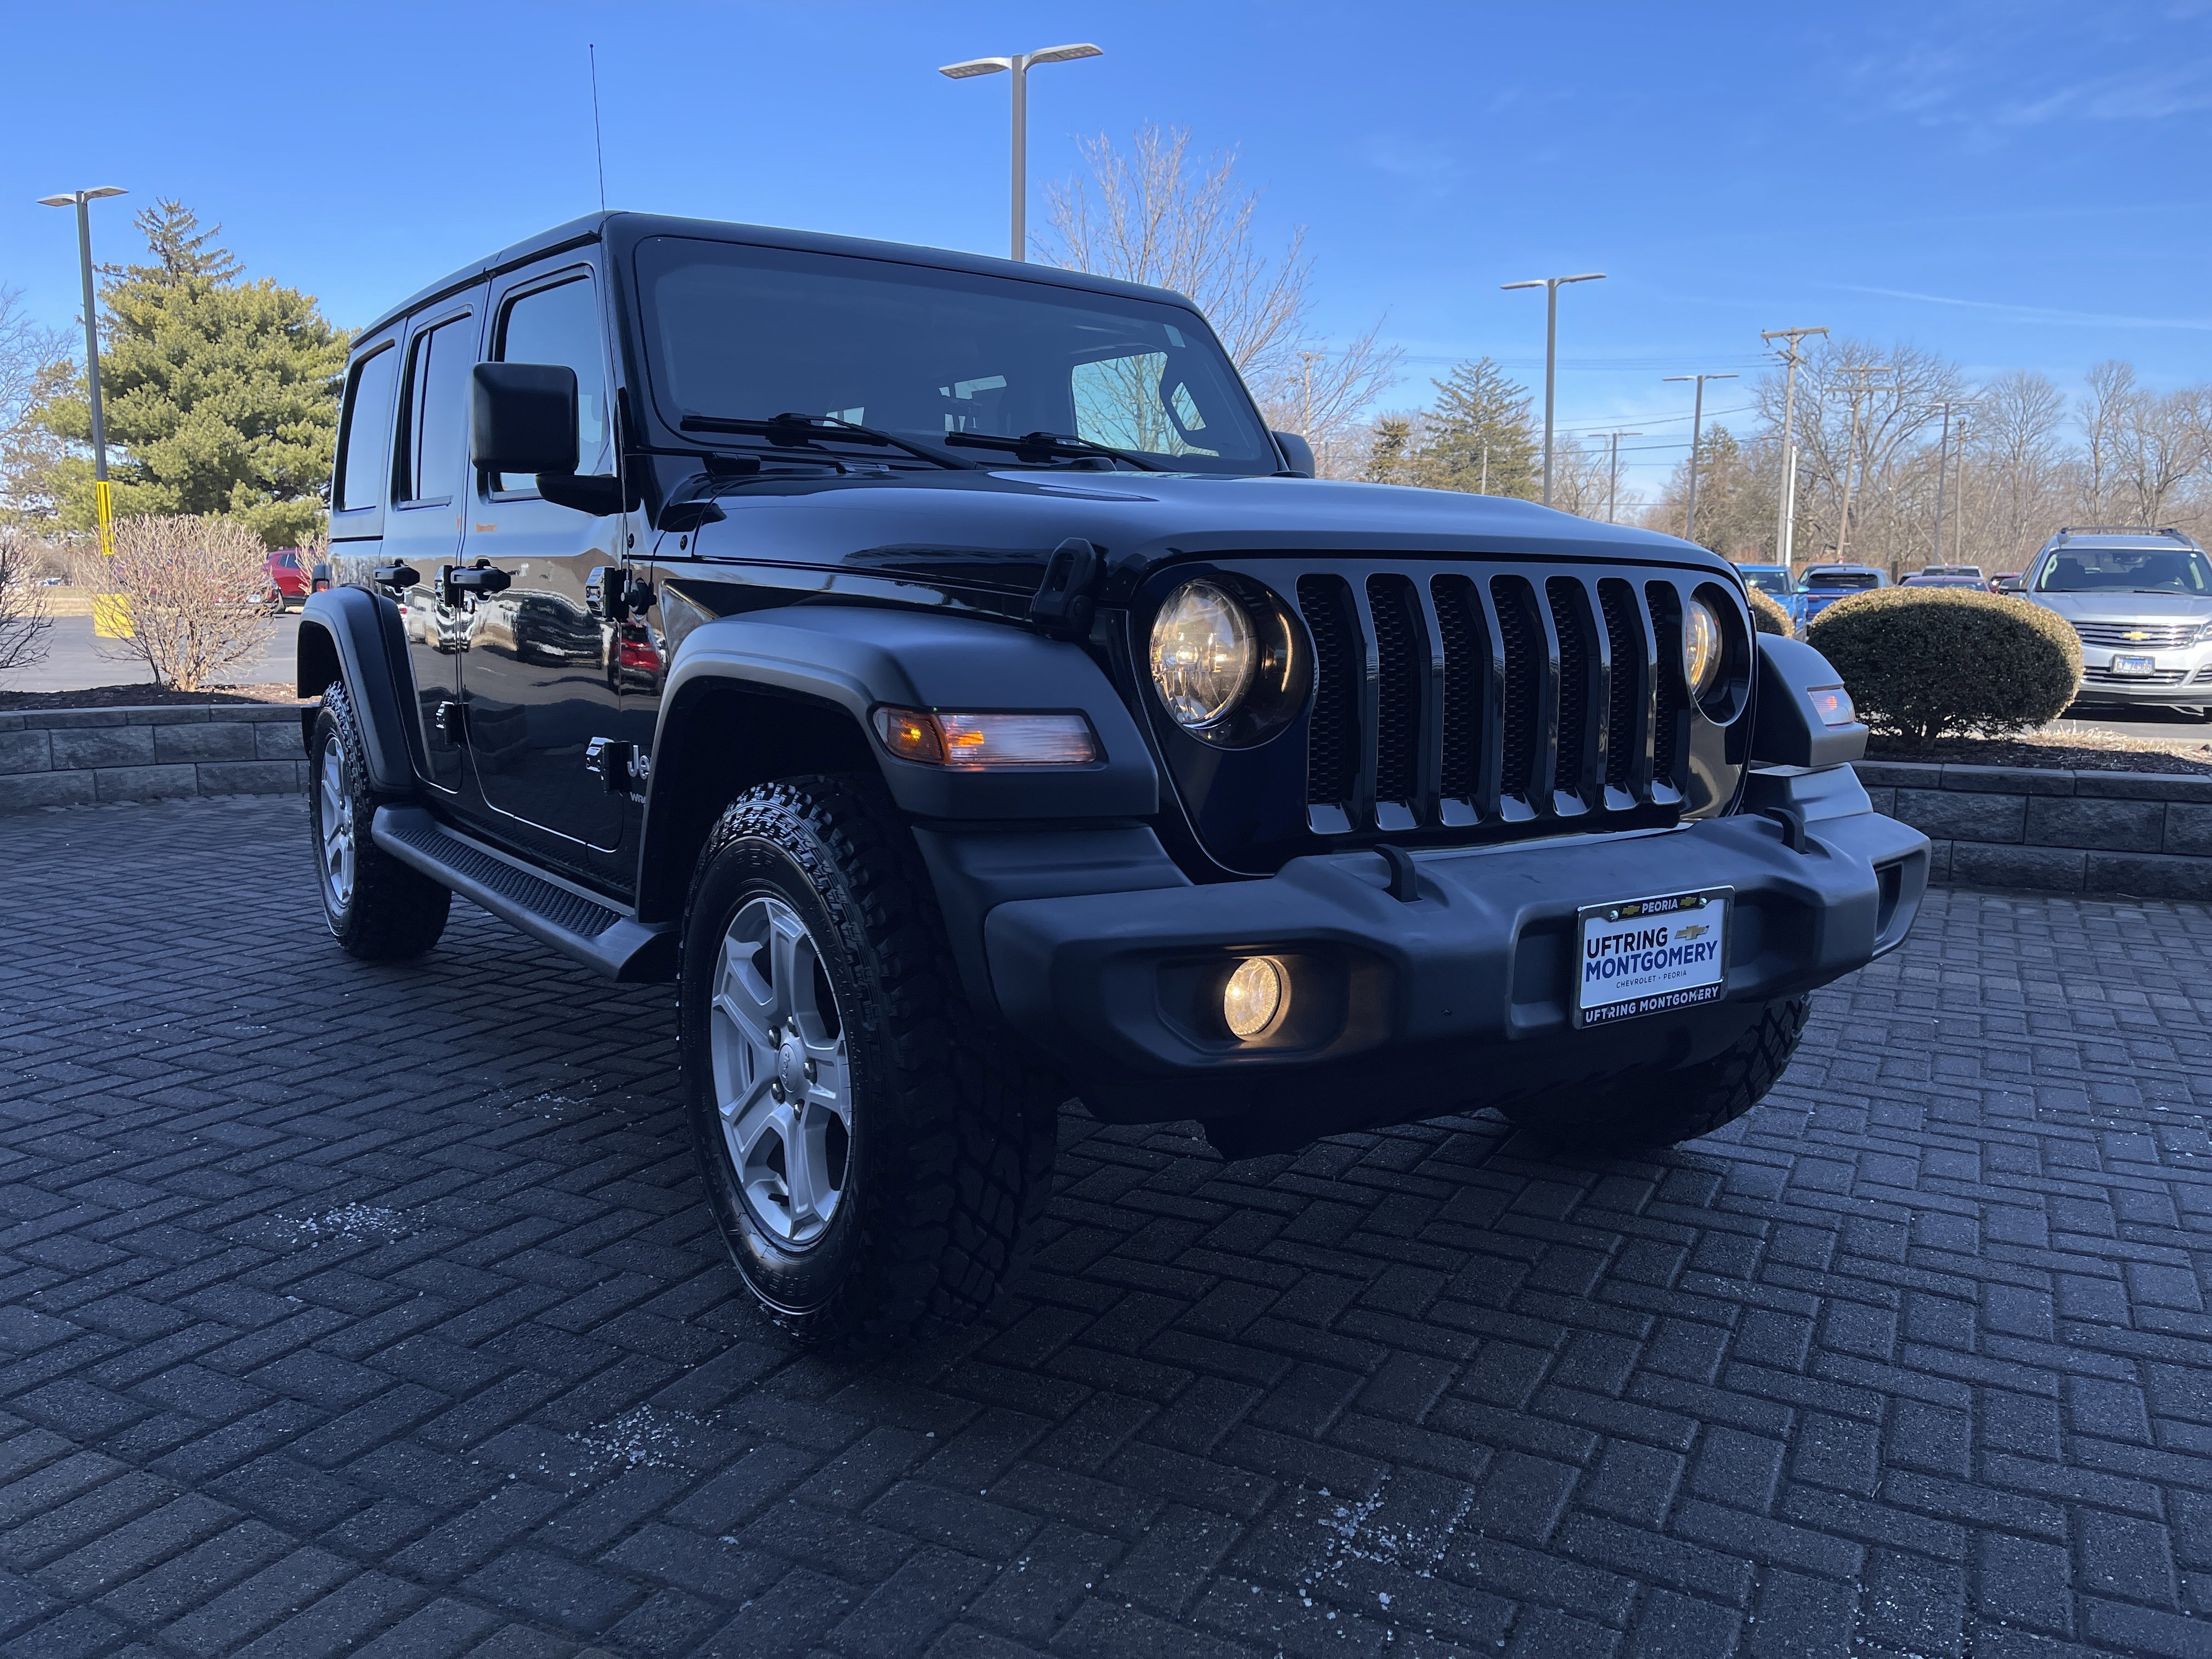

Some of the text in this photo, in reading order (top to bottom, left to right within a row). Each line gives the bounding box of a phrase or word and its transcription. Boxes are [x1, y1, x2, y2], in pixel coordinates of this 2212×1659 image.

[627, 744, 651, 780] Je
[1641, 898, 1678, 914] PEORIA
[1587, 927, 1668, 959] UFTRING
[1585, 940, 1718, 982] MONTGOMERY
[1616, 969, 1687, 989] CHEVROLET PEORIA
[1585, 986, 1719, 1023] UFTRING MONTGOMERY
